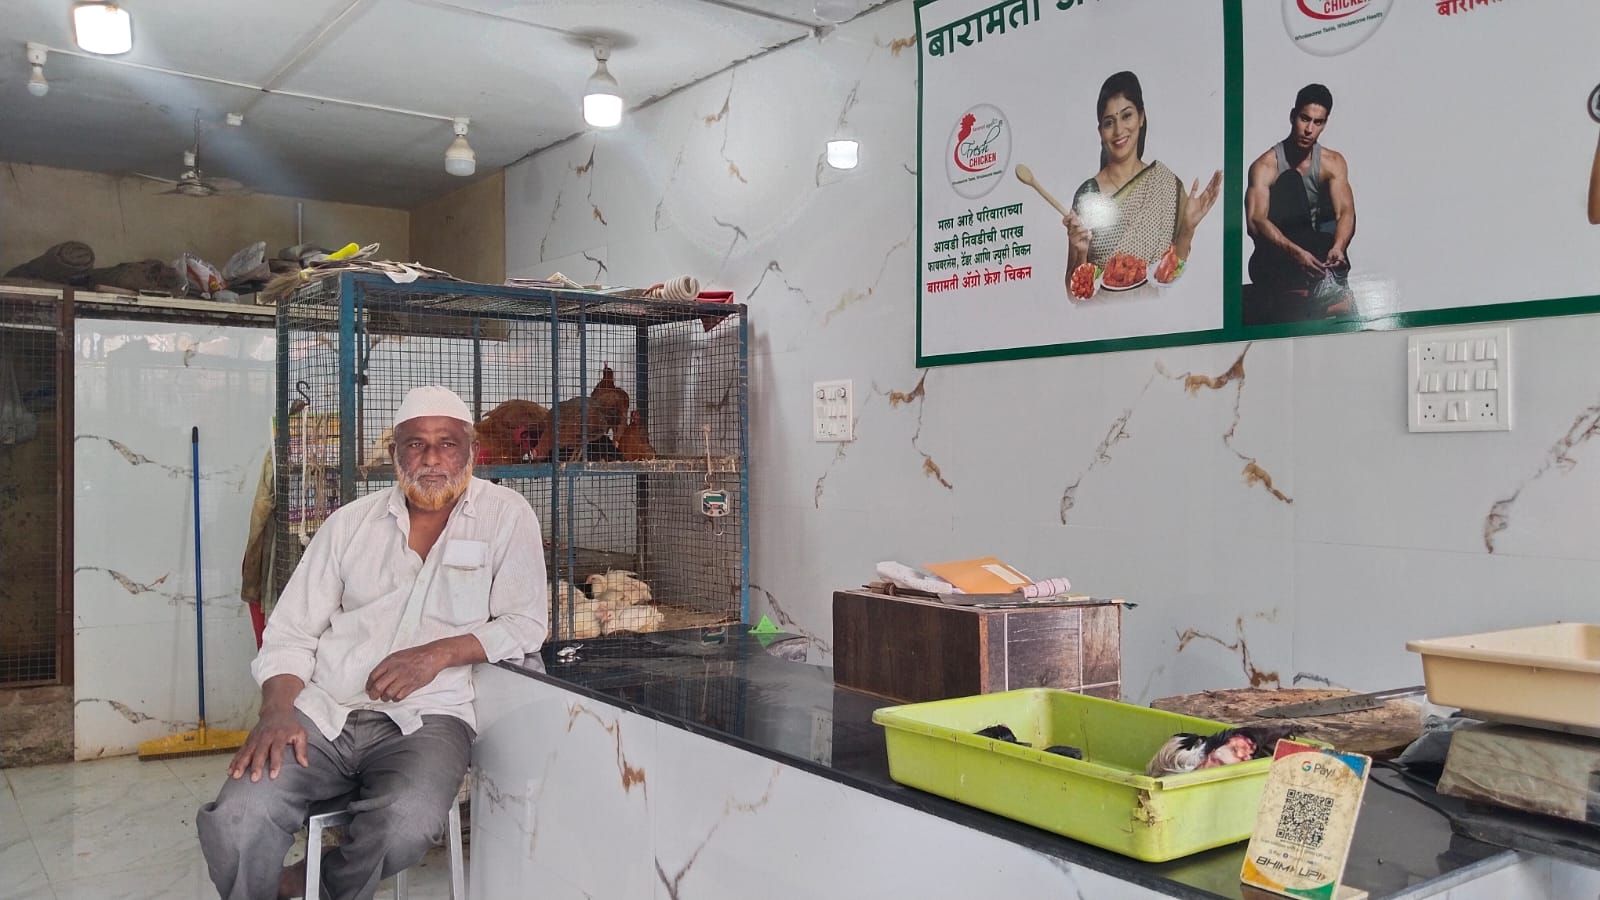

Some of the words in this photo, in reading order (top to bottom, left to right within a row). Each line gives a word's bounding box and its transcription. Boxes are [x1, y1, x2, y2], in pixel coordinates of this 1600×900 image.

[969, 152, 997, 168] CHICKEN
[938, 217, 954, 231] मला
[957, 209, 974, 226] आहे
[976, 202, 1023, 223] परिवाराच्या
[933, 234, 959, 253] आवडी
[962, 226, 997, 248] निवडीची
[1000, 225, 1024, 240] पारख
[974, 247, 991, 264] आणि
[1012, 241, 1031, 258] चिकन
[927, 273, 959, 294] बारामती
[984, 267, 1001, 286] फ्रेश
[1004, 264, 1032, 282] चिकन
[1302, 760, 1312, 772] G
[1256, 855, 1291, 872] BHIM
